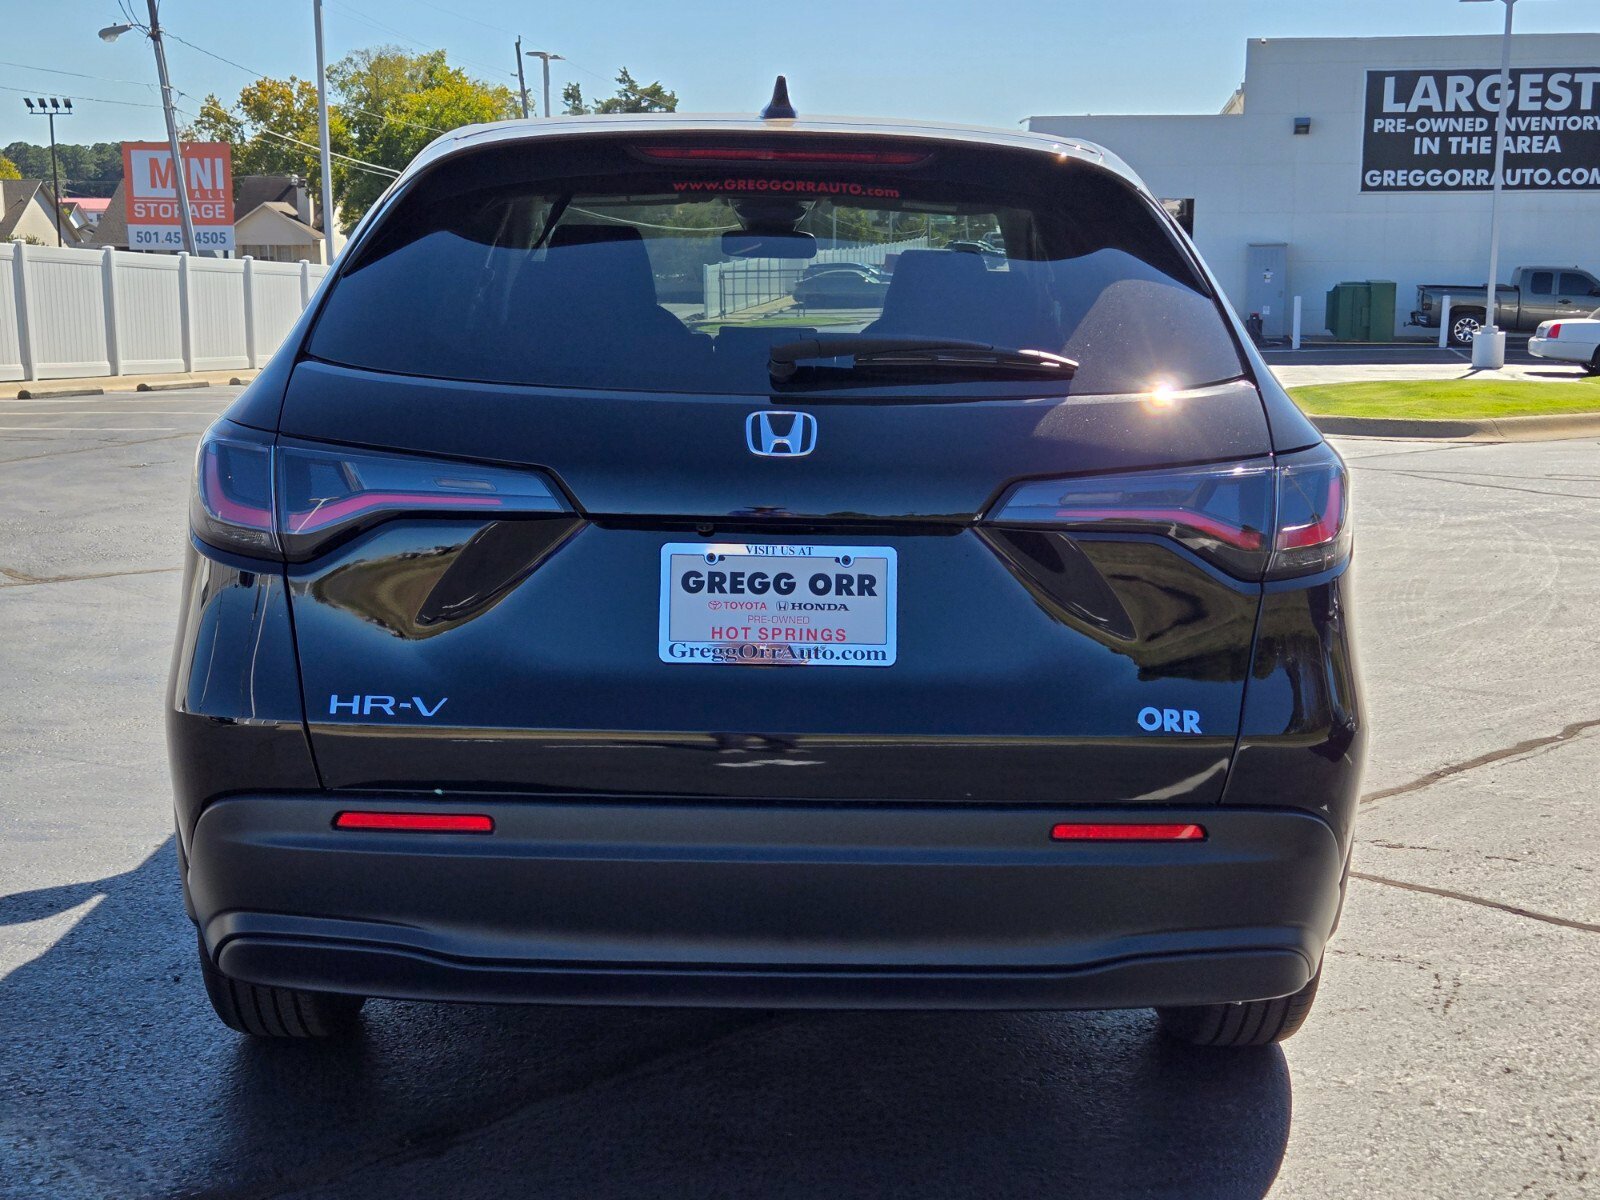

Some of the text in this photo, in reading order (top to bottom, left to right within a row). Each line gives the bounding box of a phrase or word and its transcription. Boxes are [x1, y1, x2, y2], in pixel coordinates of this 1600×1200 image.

[1382, 72, 1600, 113] LARGEST
[1373, 117, 1489, 133] PRE-OWNED
[1413, 135, 1562, 155] IN THE AREA
[673, 178, 900, 198] www.GREGGORRAUTO.com
[746, 545, 814, 556] VISIT US AT
[681, 570, 878, 597] GREGG ORR
[723, 601, 850, 612] TOYOTA HONDA
[747, 614, 810, 625] PRE-OWNED
[711, 626, 847, 642] HOT SPRINGS
[668, 642, 888, 662] GreggOrrAuto.com
[329, 694, 449, 717] HR-V
[1137, 706, 1203, 735] ORR
